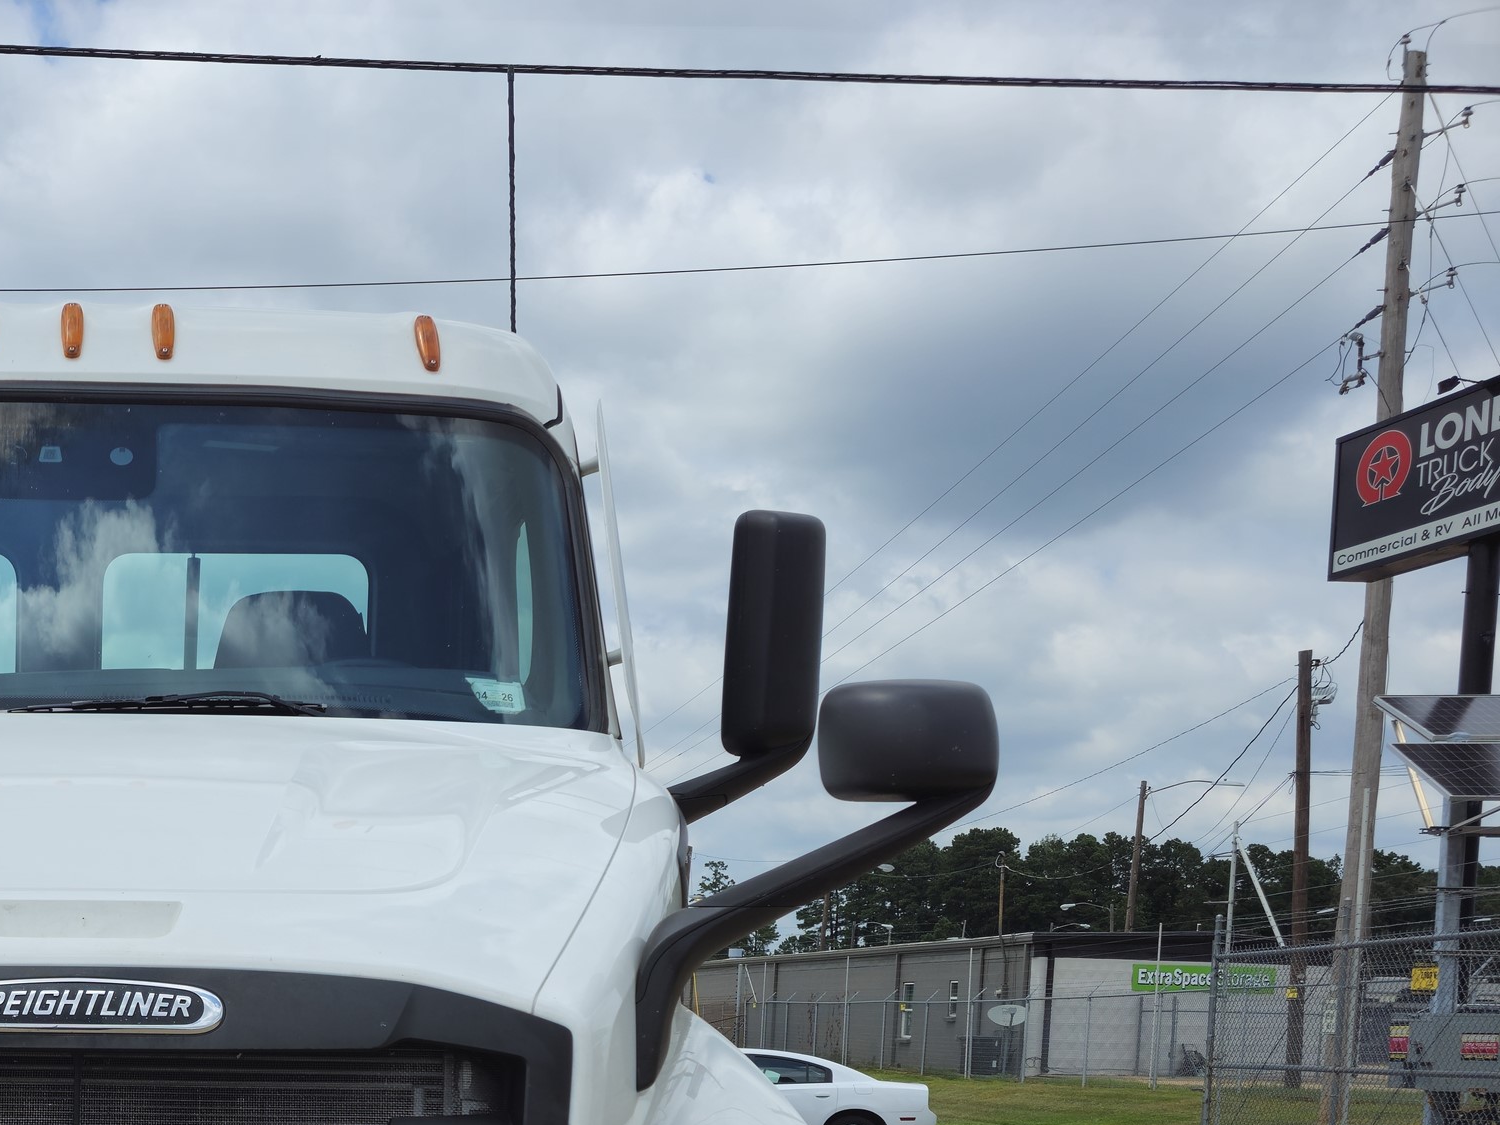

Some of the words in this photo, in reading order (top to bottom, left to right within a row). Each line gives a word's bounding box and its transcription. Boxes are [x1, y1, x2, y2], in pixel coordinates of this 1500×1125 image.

[1416, 437, 1495, 488] TRUCK
[1420, 461, 1500, 515] Body
[1336, 532, 1417, 566] Commercial
[1421, 529, 1430, 541] &
[1435, 522, 1453, 537] RV
[1462, 513, 1481, 529] All
[501, 693, 514, 702] 26
